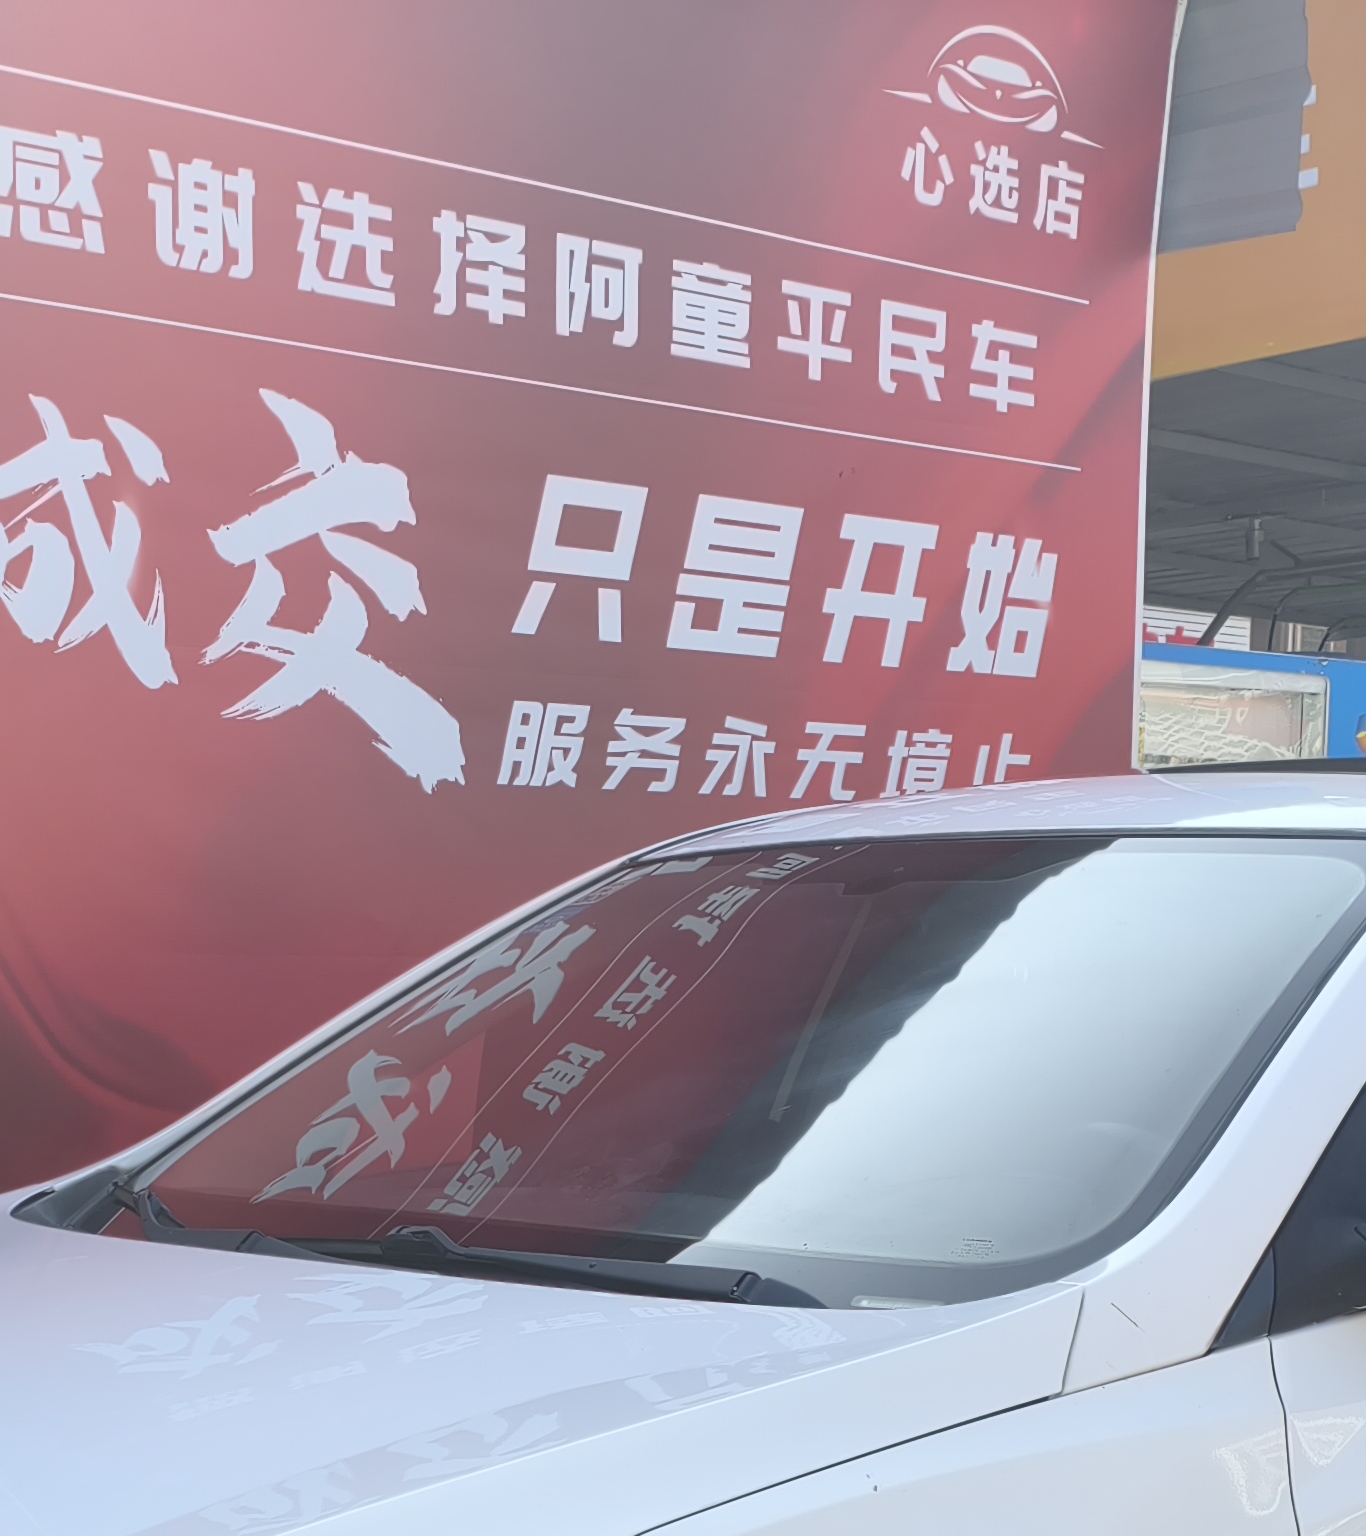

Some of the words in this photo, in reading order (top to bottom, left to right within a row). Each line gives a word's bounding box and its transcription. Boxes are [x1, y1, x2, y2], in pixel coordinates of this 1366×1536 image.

[900, 125, 1085, 241] 心选店
[510, 473, 1058, 679] 只是开始
